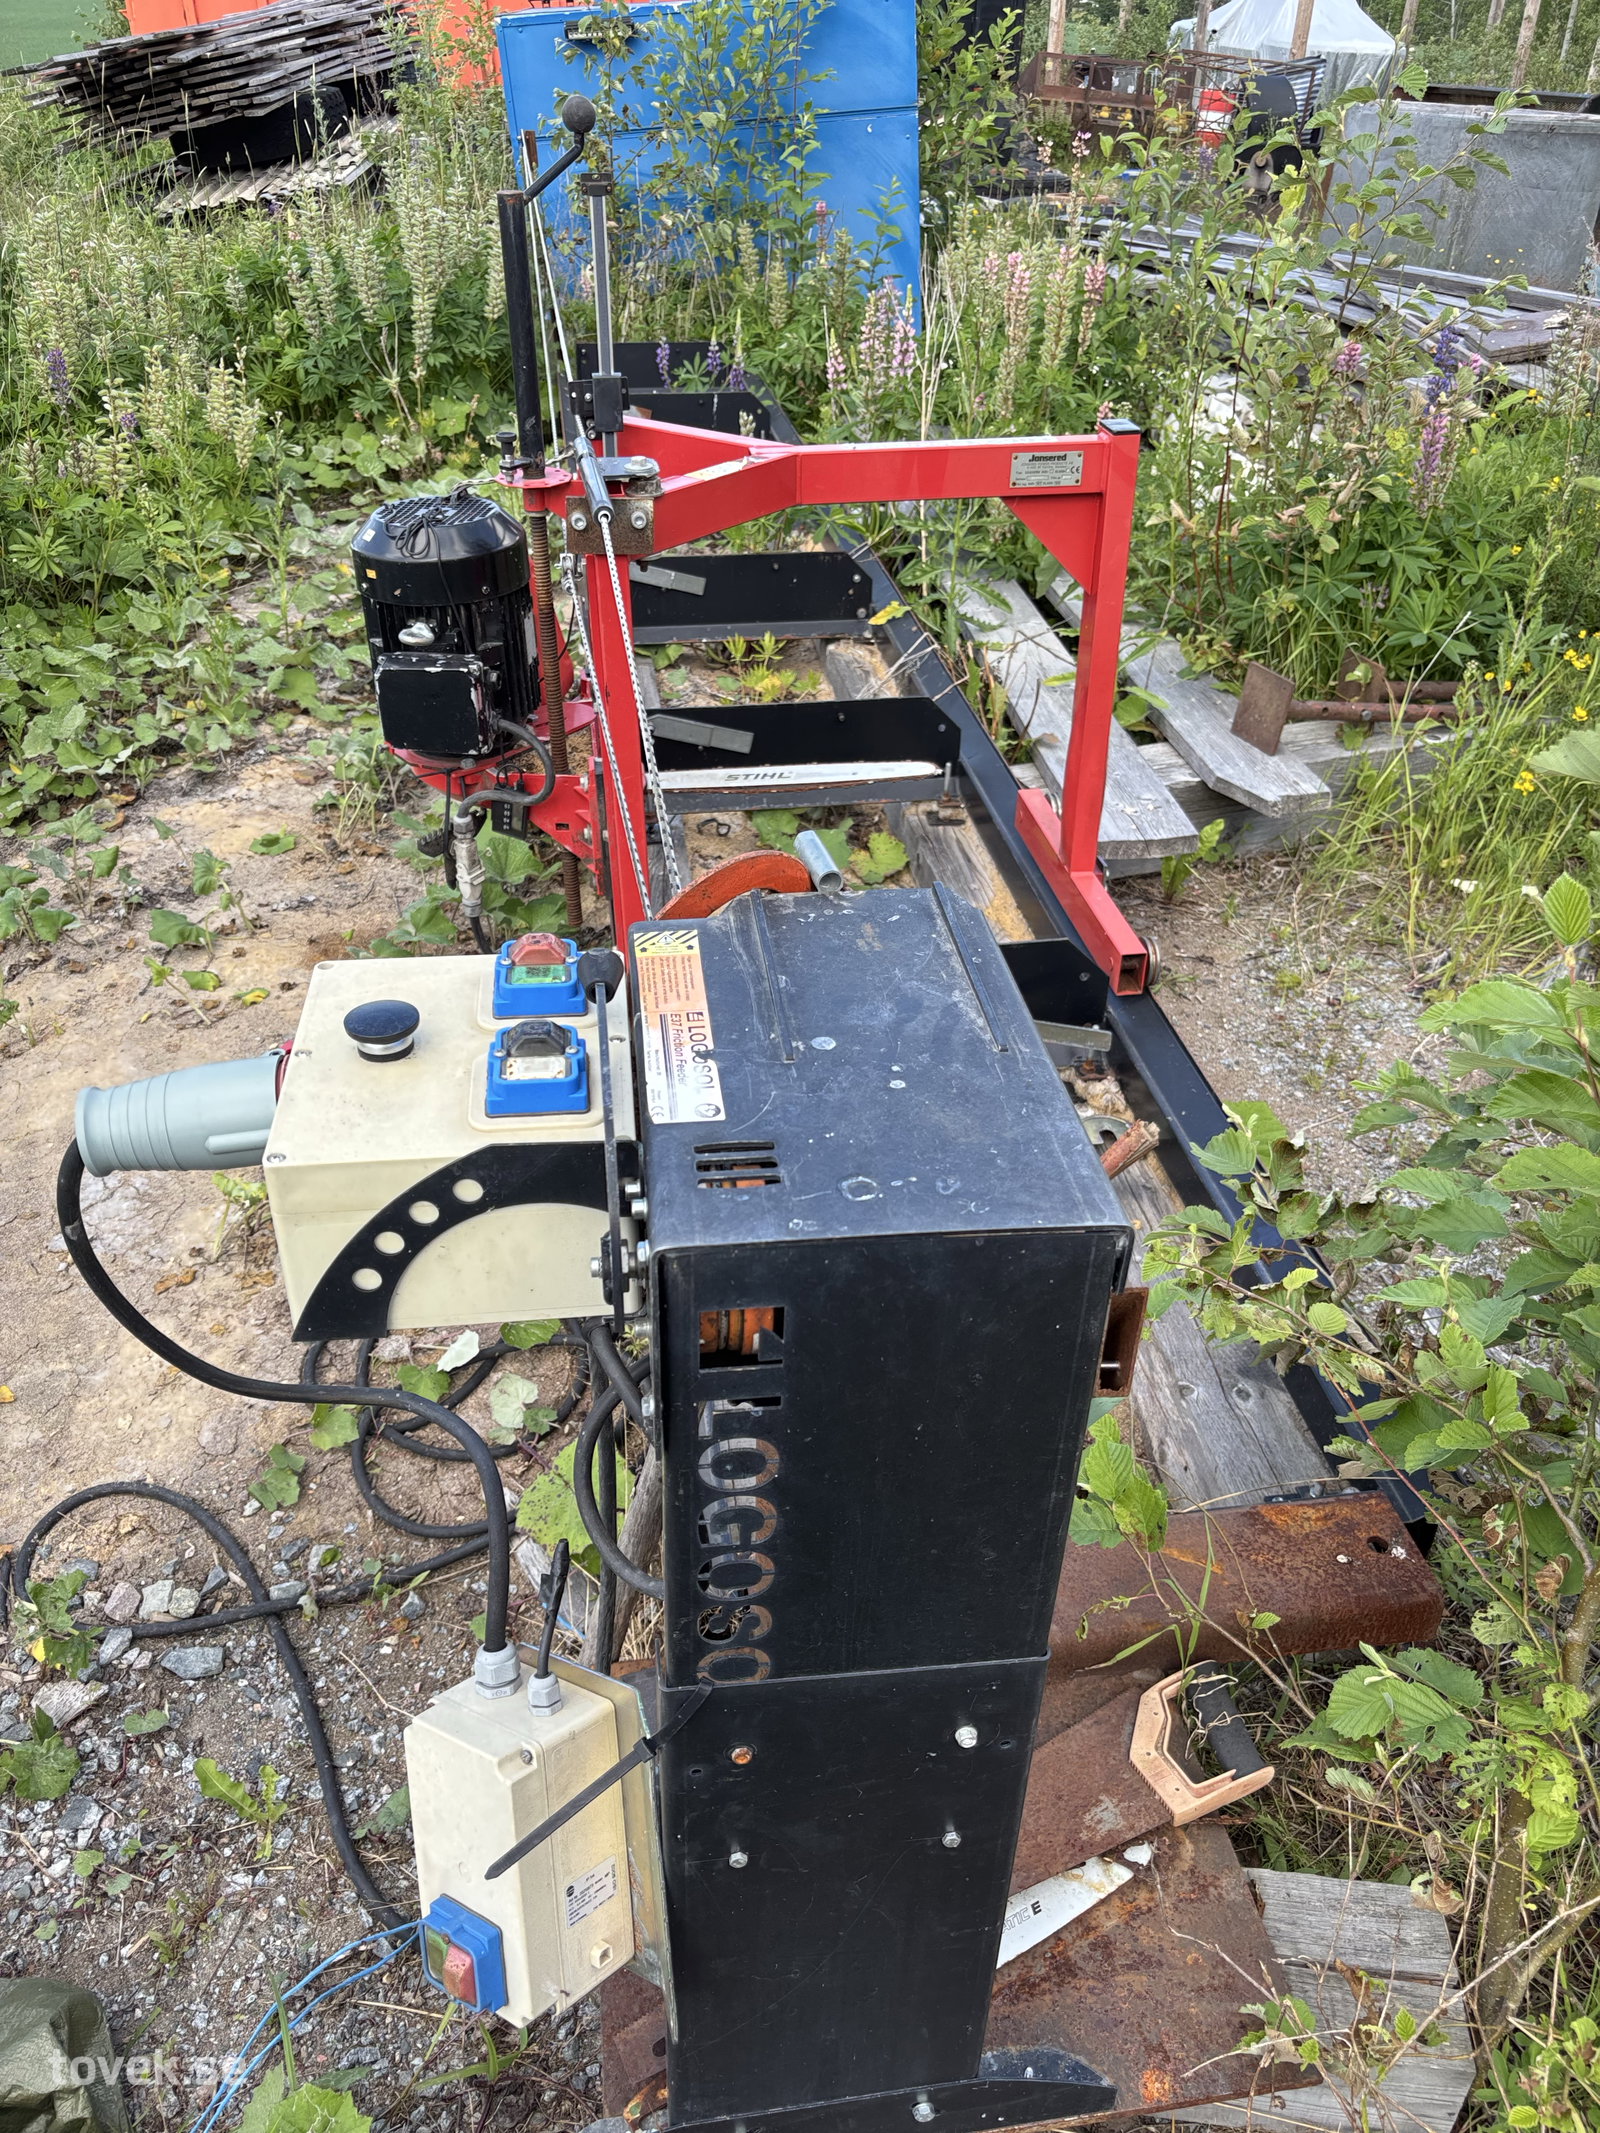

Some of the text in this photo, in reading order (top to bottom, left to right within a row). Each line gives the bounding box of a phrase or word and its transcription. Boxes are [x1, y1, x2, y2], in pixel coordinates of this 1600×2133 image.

[1028, 453, 1067, 462] Jonsered
[724, 773, 790, 782] STIHL
[669, 1013, 690, 1087] E37 Friction Feeder
[1031, 1900, 1042, 1916] E
